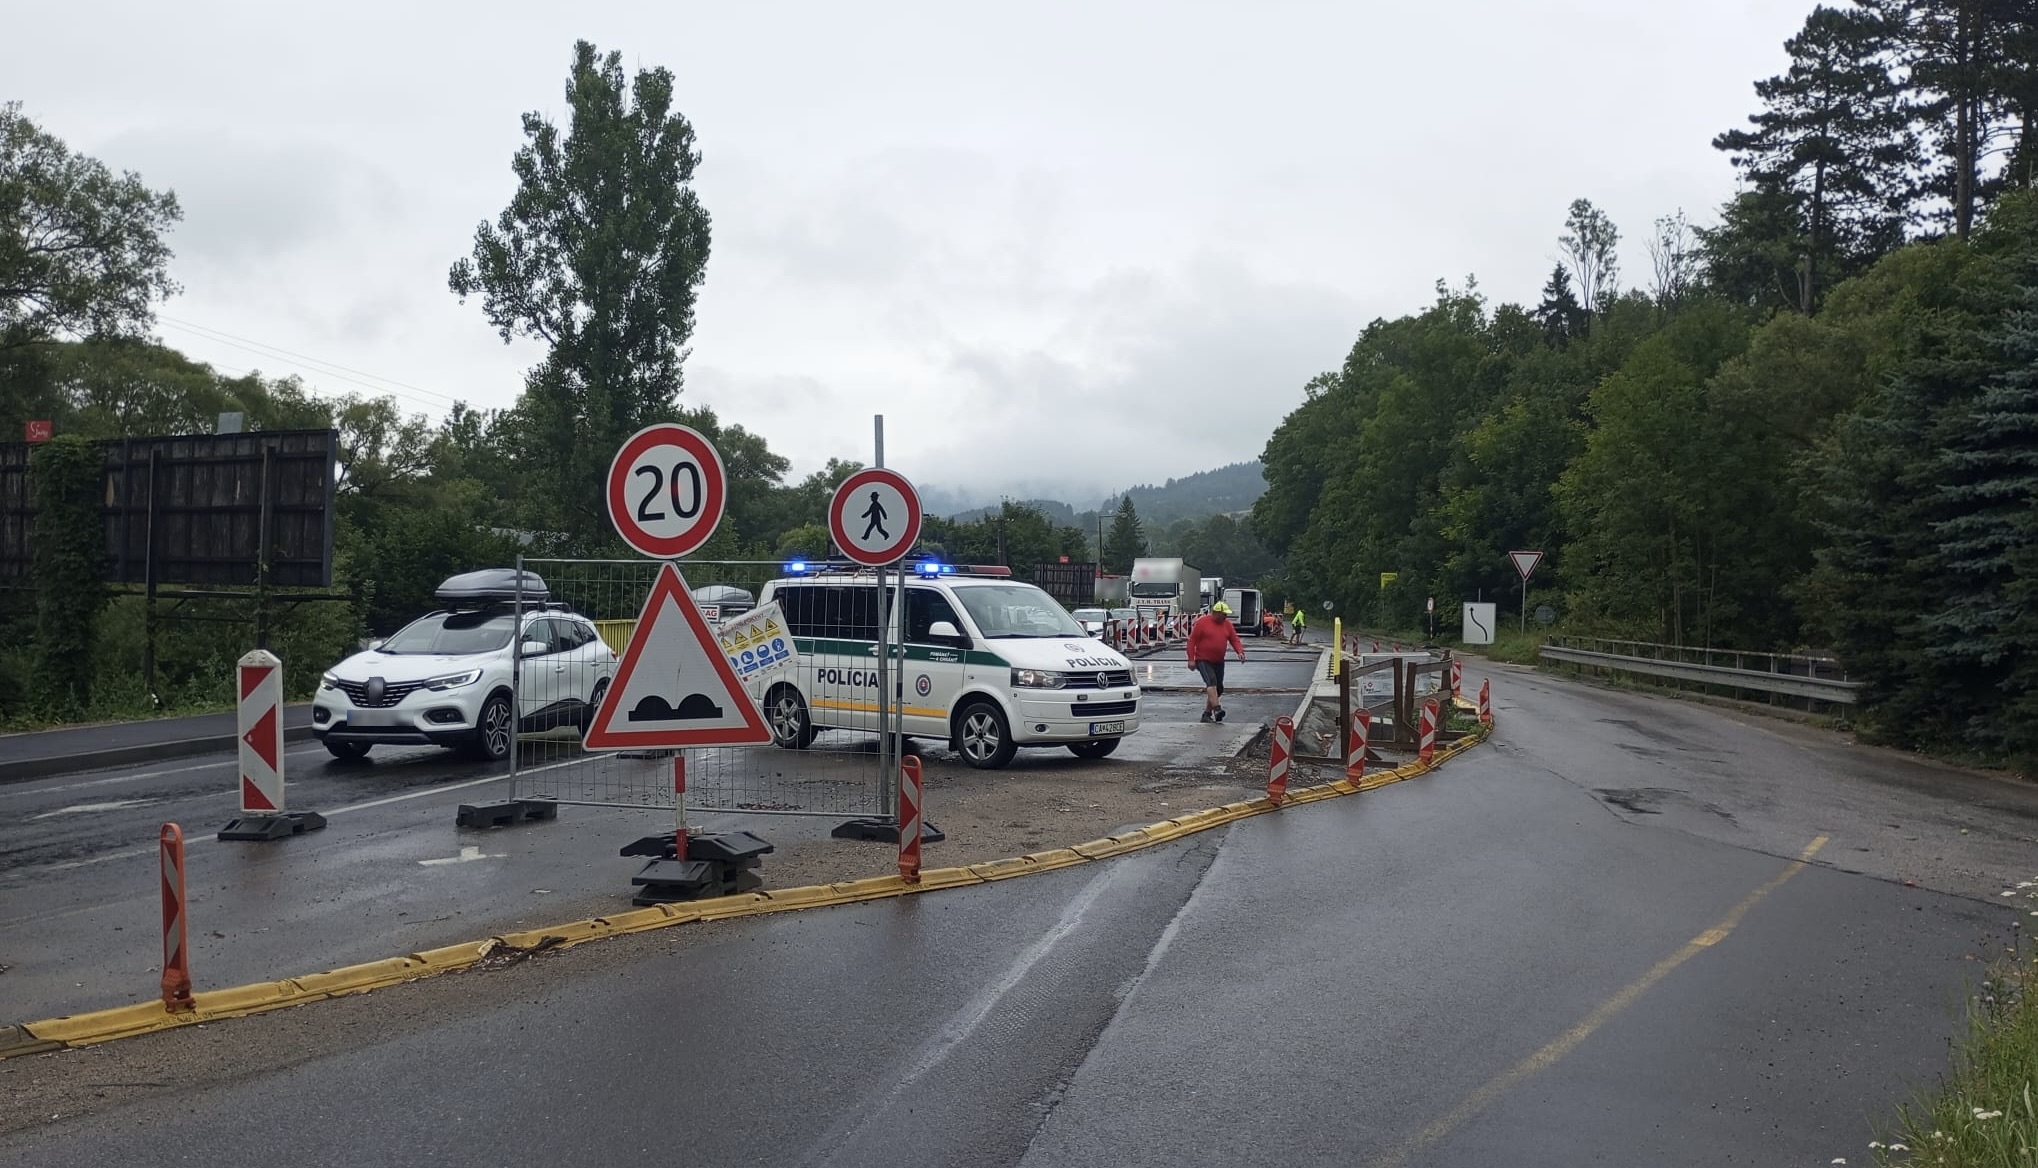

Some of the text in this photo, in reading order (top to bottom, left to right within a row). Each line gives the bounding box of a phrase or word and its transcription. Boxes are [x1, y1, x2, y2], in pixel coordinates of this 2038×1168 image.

[635, 461, 701, 521] 20
[1066, 656, 1122, 668] POLÍCIA
[817, 667, 879, 688] POLÍCIA
